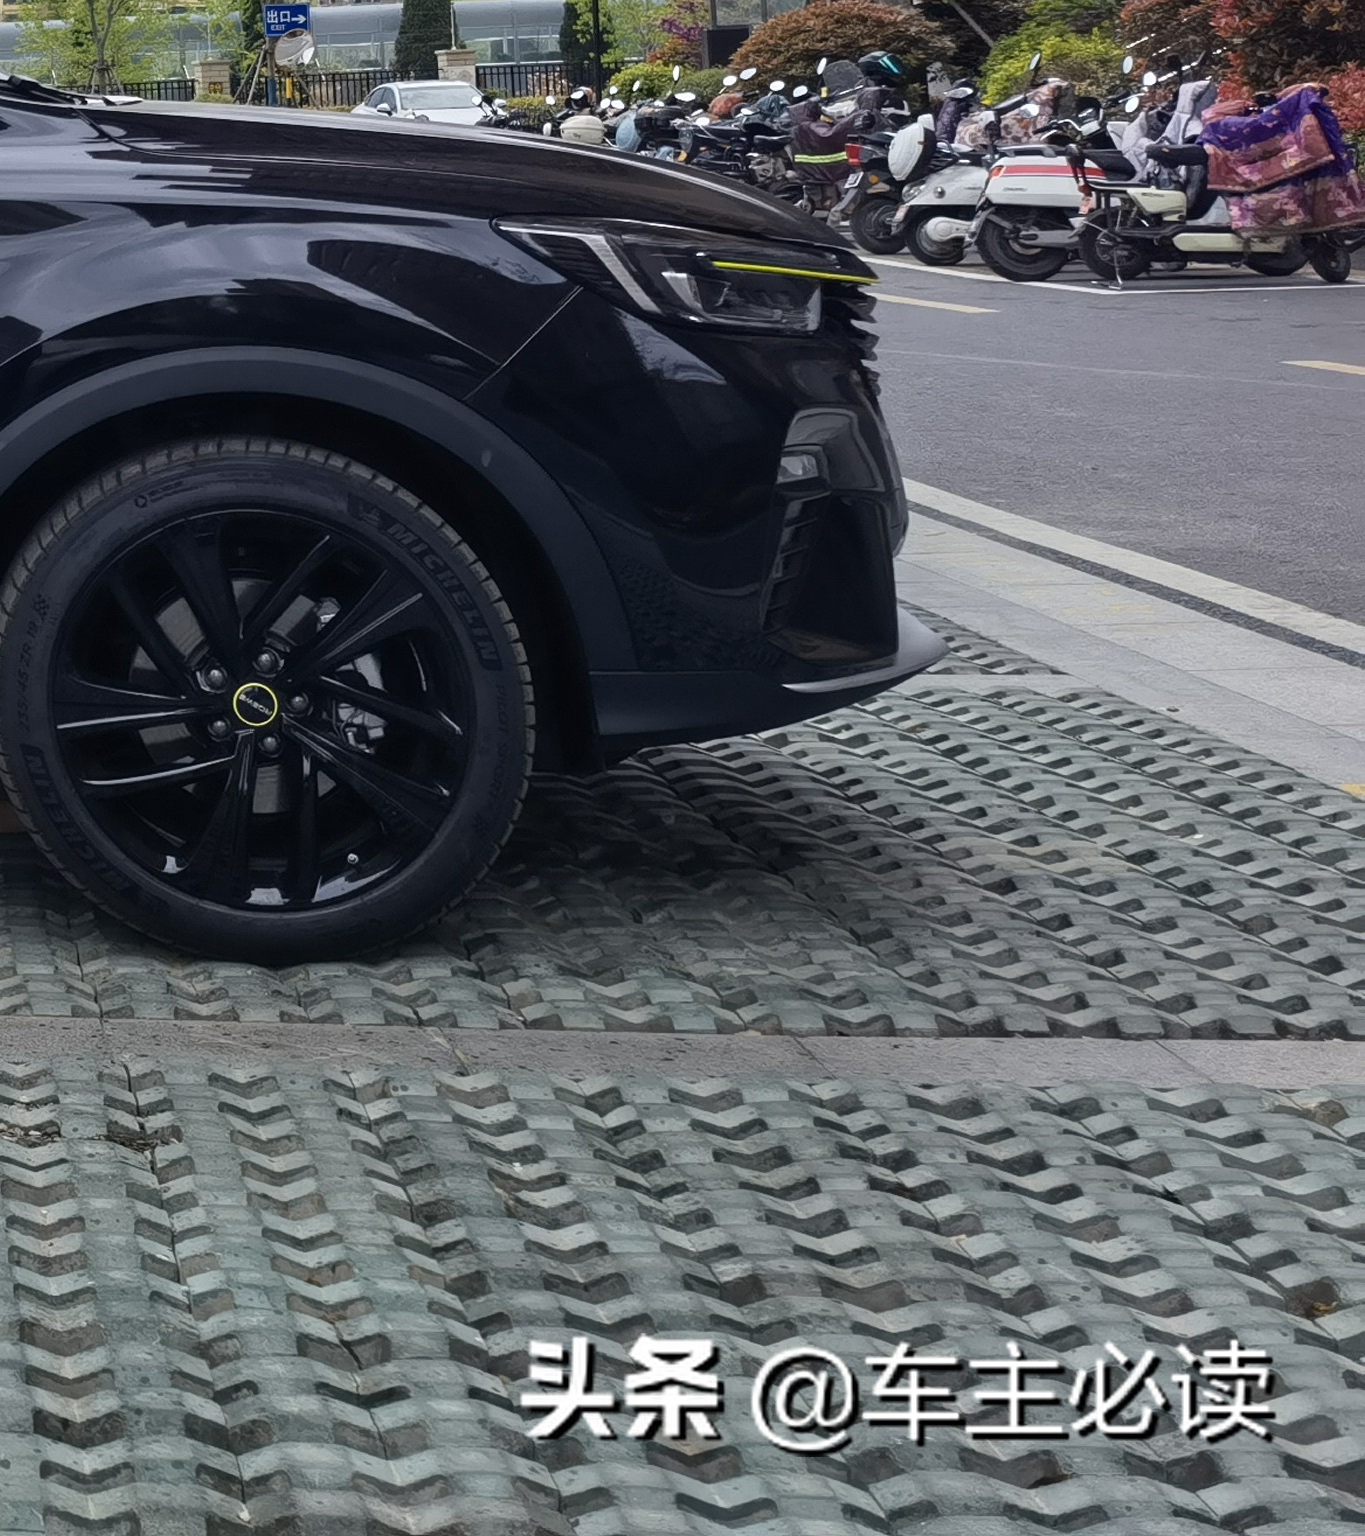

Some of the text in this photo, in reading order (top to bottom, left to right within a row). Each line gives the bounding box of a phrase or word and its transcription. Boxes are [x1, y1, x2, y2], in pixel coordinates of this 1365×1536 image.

[266, 9, 291, 23] 出口
[386, 522, 499, 662] MICHELIN
[24, 753, 133, 892] MICHELIN
